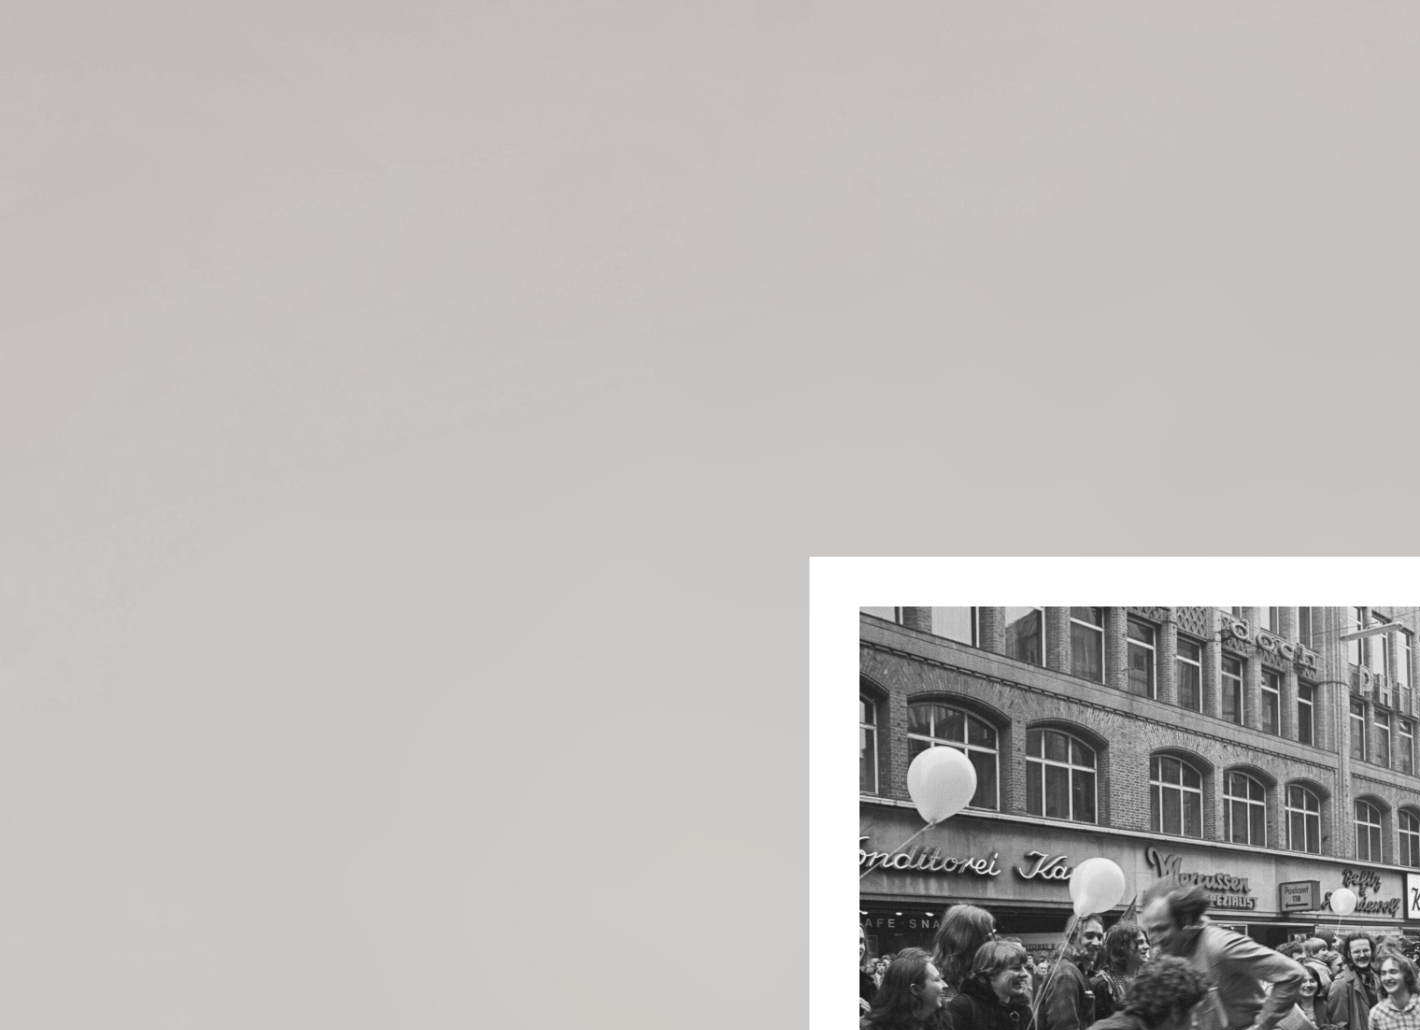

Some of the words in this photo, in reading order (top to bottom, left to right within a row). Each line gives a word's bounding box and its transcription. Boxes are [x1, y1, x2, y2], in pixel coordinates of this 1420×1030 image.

[860, 836, 1001, 877] onditorei
[1017, 850, 1073, 880] Ka
[1284, 885, 1309, 895] Postamt
[864, 917, 896, 929] AFE
[909, 918, 940, 930] SNA
